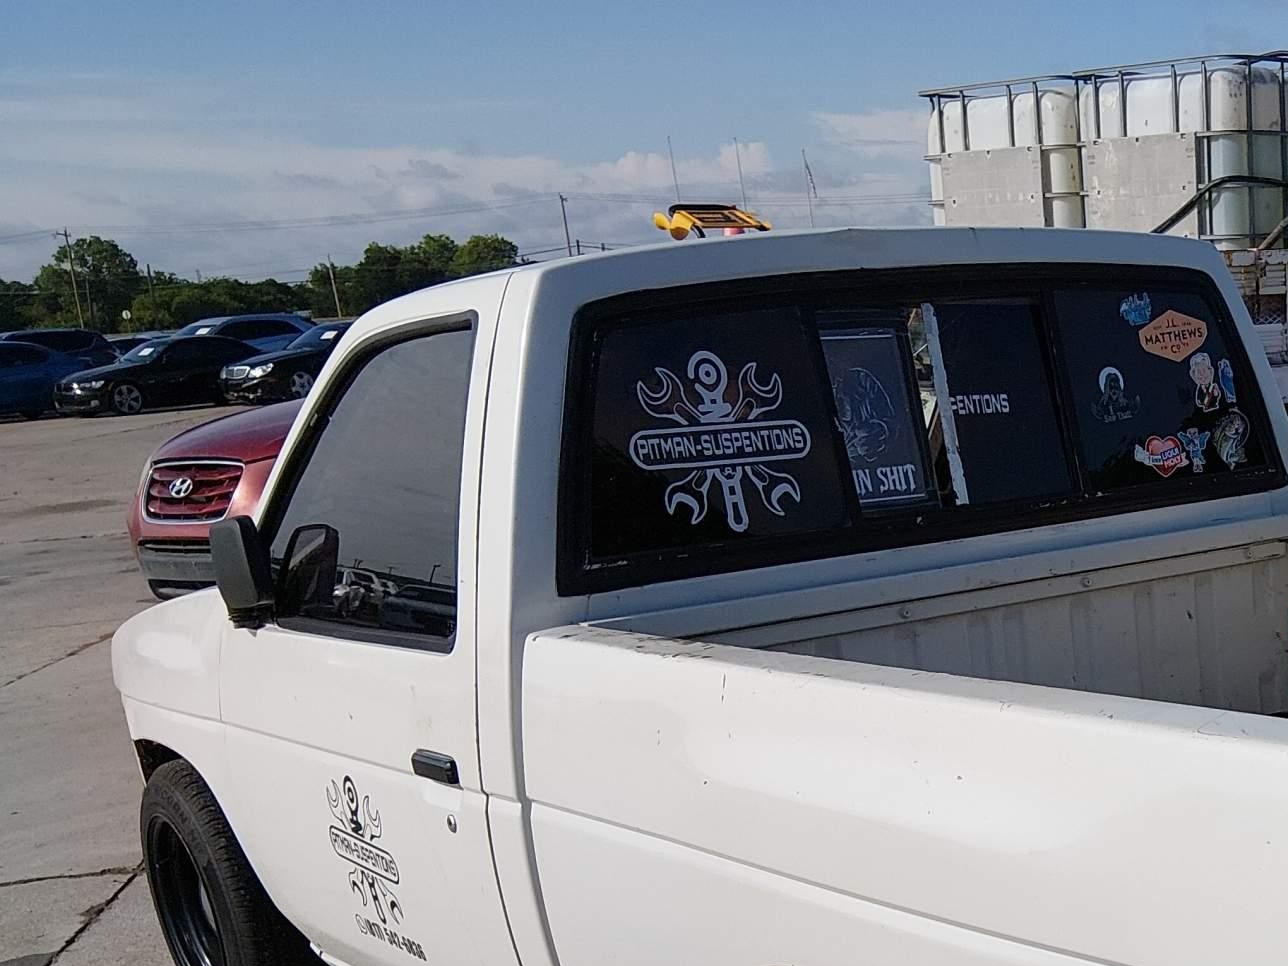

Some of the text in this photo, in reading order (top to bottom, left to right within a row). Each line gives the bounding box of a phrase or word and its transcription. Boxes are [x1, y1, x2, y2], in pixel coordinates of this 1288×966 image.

[1144, 327, 1203, 346] MATTHEWS
[636, 427, 804, 461] PITMAN-SUSPENTIONS
[876, 463, 916, 495] SHIT
